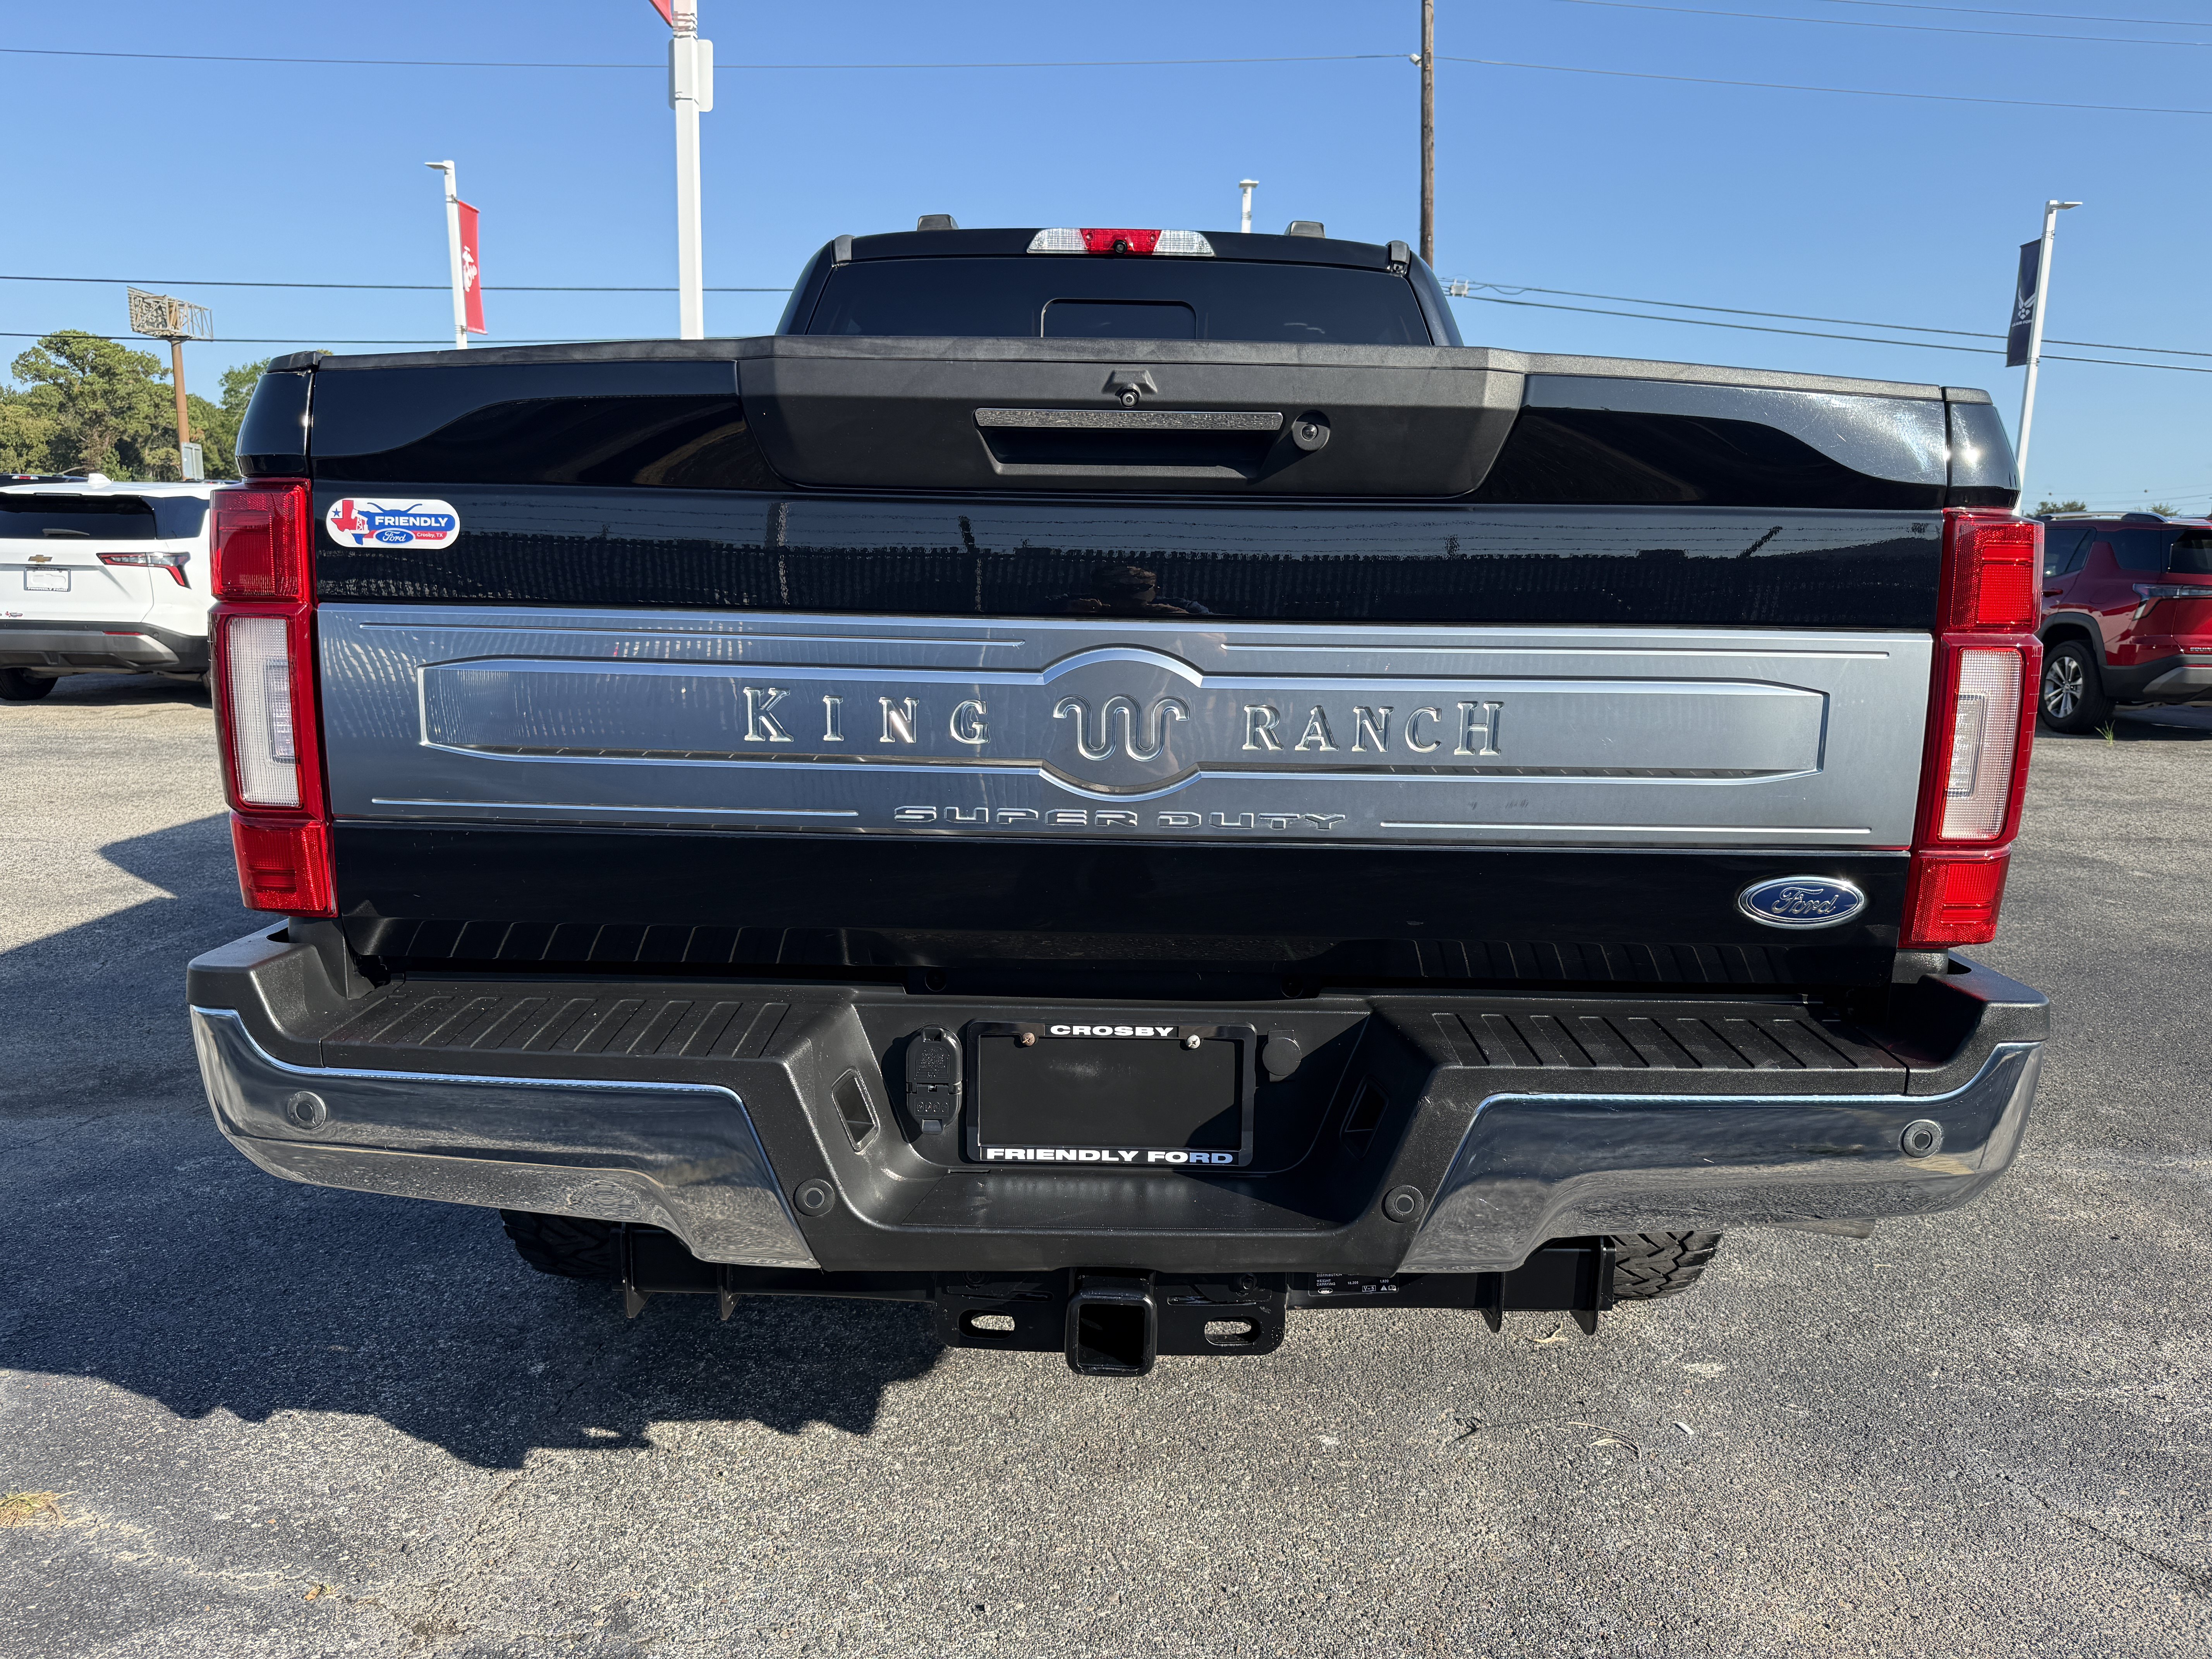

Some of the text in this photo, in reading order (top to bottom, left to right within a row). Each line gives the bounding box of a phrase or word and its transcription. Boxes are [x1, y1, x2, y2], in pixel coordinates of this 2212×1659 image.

[375, 516, 448, 527] FRIENDLY
[383, 531, 406, 542] Ford
[743, 687, 1504, 756] KING RANCH
[894, 805, 1346, 830] SUPER DUTY
[1771, 887, 1839, 915] Ford
[1050, 1024, 1174, 1037] CROSBY
[986, 1149, 1233, 1164] FRIENDLY FORD
